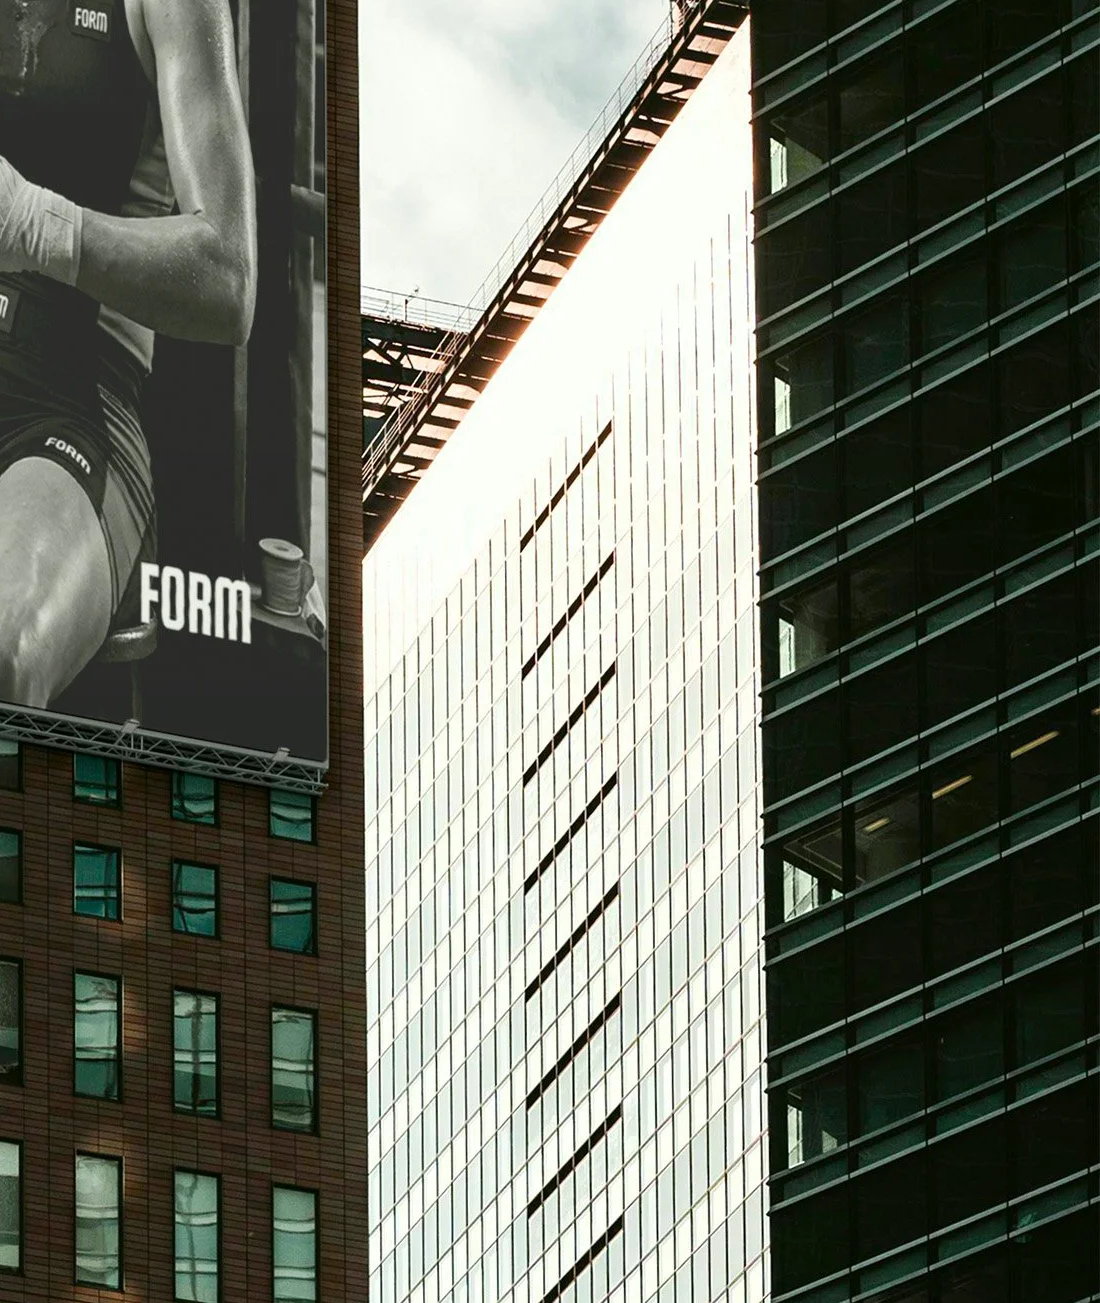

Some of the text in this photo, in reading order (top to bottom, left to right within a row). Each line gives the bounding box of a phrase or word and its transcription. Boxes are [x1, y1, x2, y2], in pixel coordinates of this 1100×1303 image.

[74, 7, 108, 33] FORM
[45, 436, 91, 475] FORM
[141, 562, 251, 644] FORM
